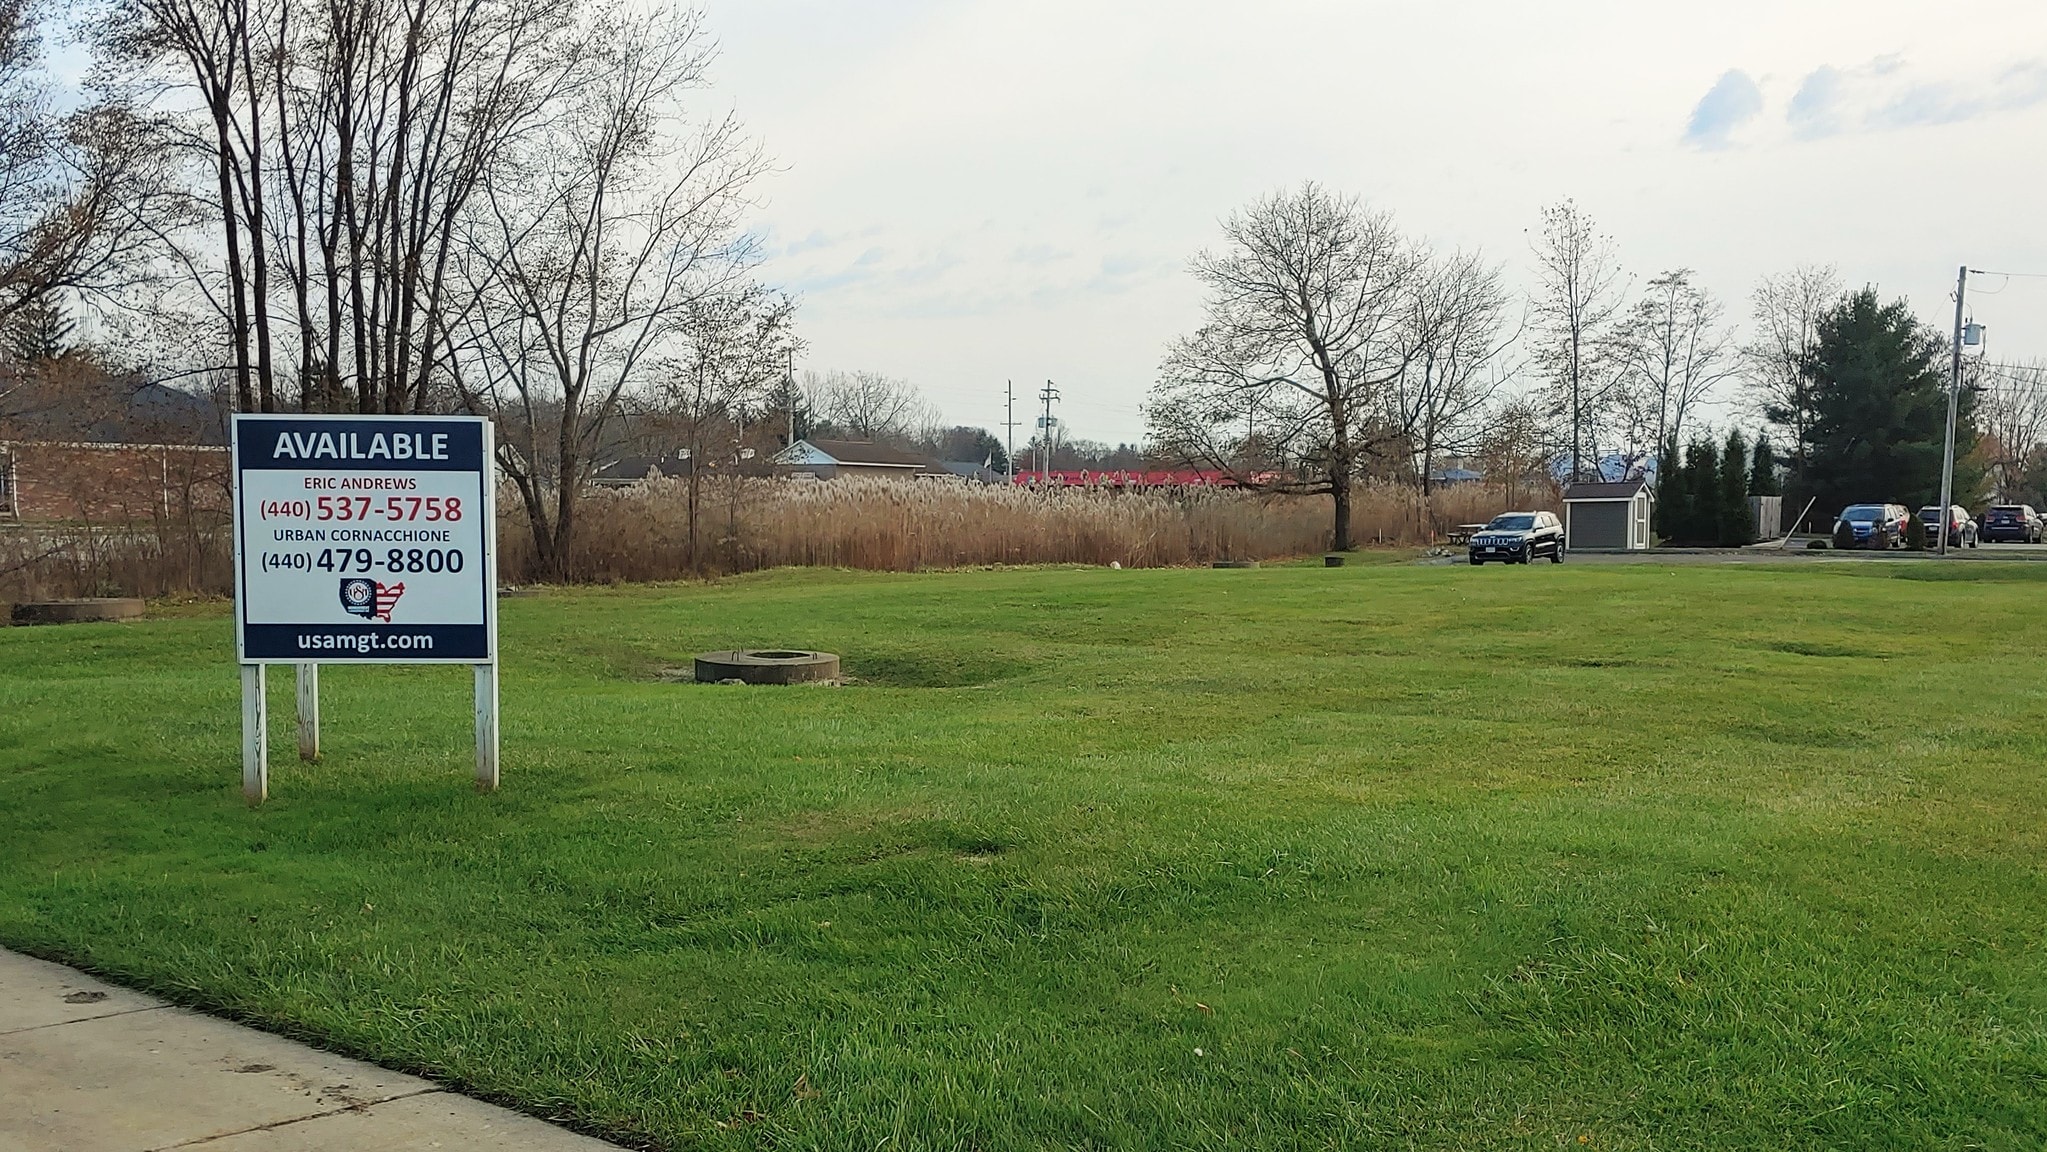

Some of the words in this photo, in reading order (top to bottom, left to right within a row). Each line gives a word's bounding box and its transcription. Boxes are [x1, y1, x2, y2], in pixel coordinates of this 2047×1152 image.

[272, 432, 449, 460] AVAILABLE
[304, 477, 337, 490] ERIC
[341, 477, 417, 490] ANDREWS
[260, 499, 311, 521] (440)
[317, 496, 462, 522] 537-5758
[273, 529, 326, 542] URBAN
[330, 529, 451, 542] CORNACCHIONE
[261, 551, 312, 574] (440)
[316, 548, 464, 574] 479-8800
[298, 632, 433, 653] usamgt.com
